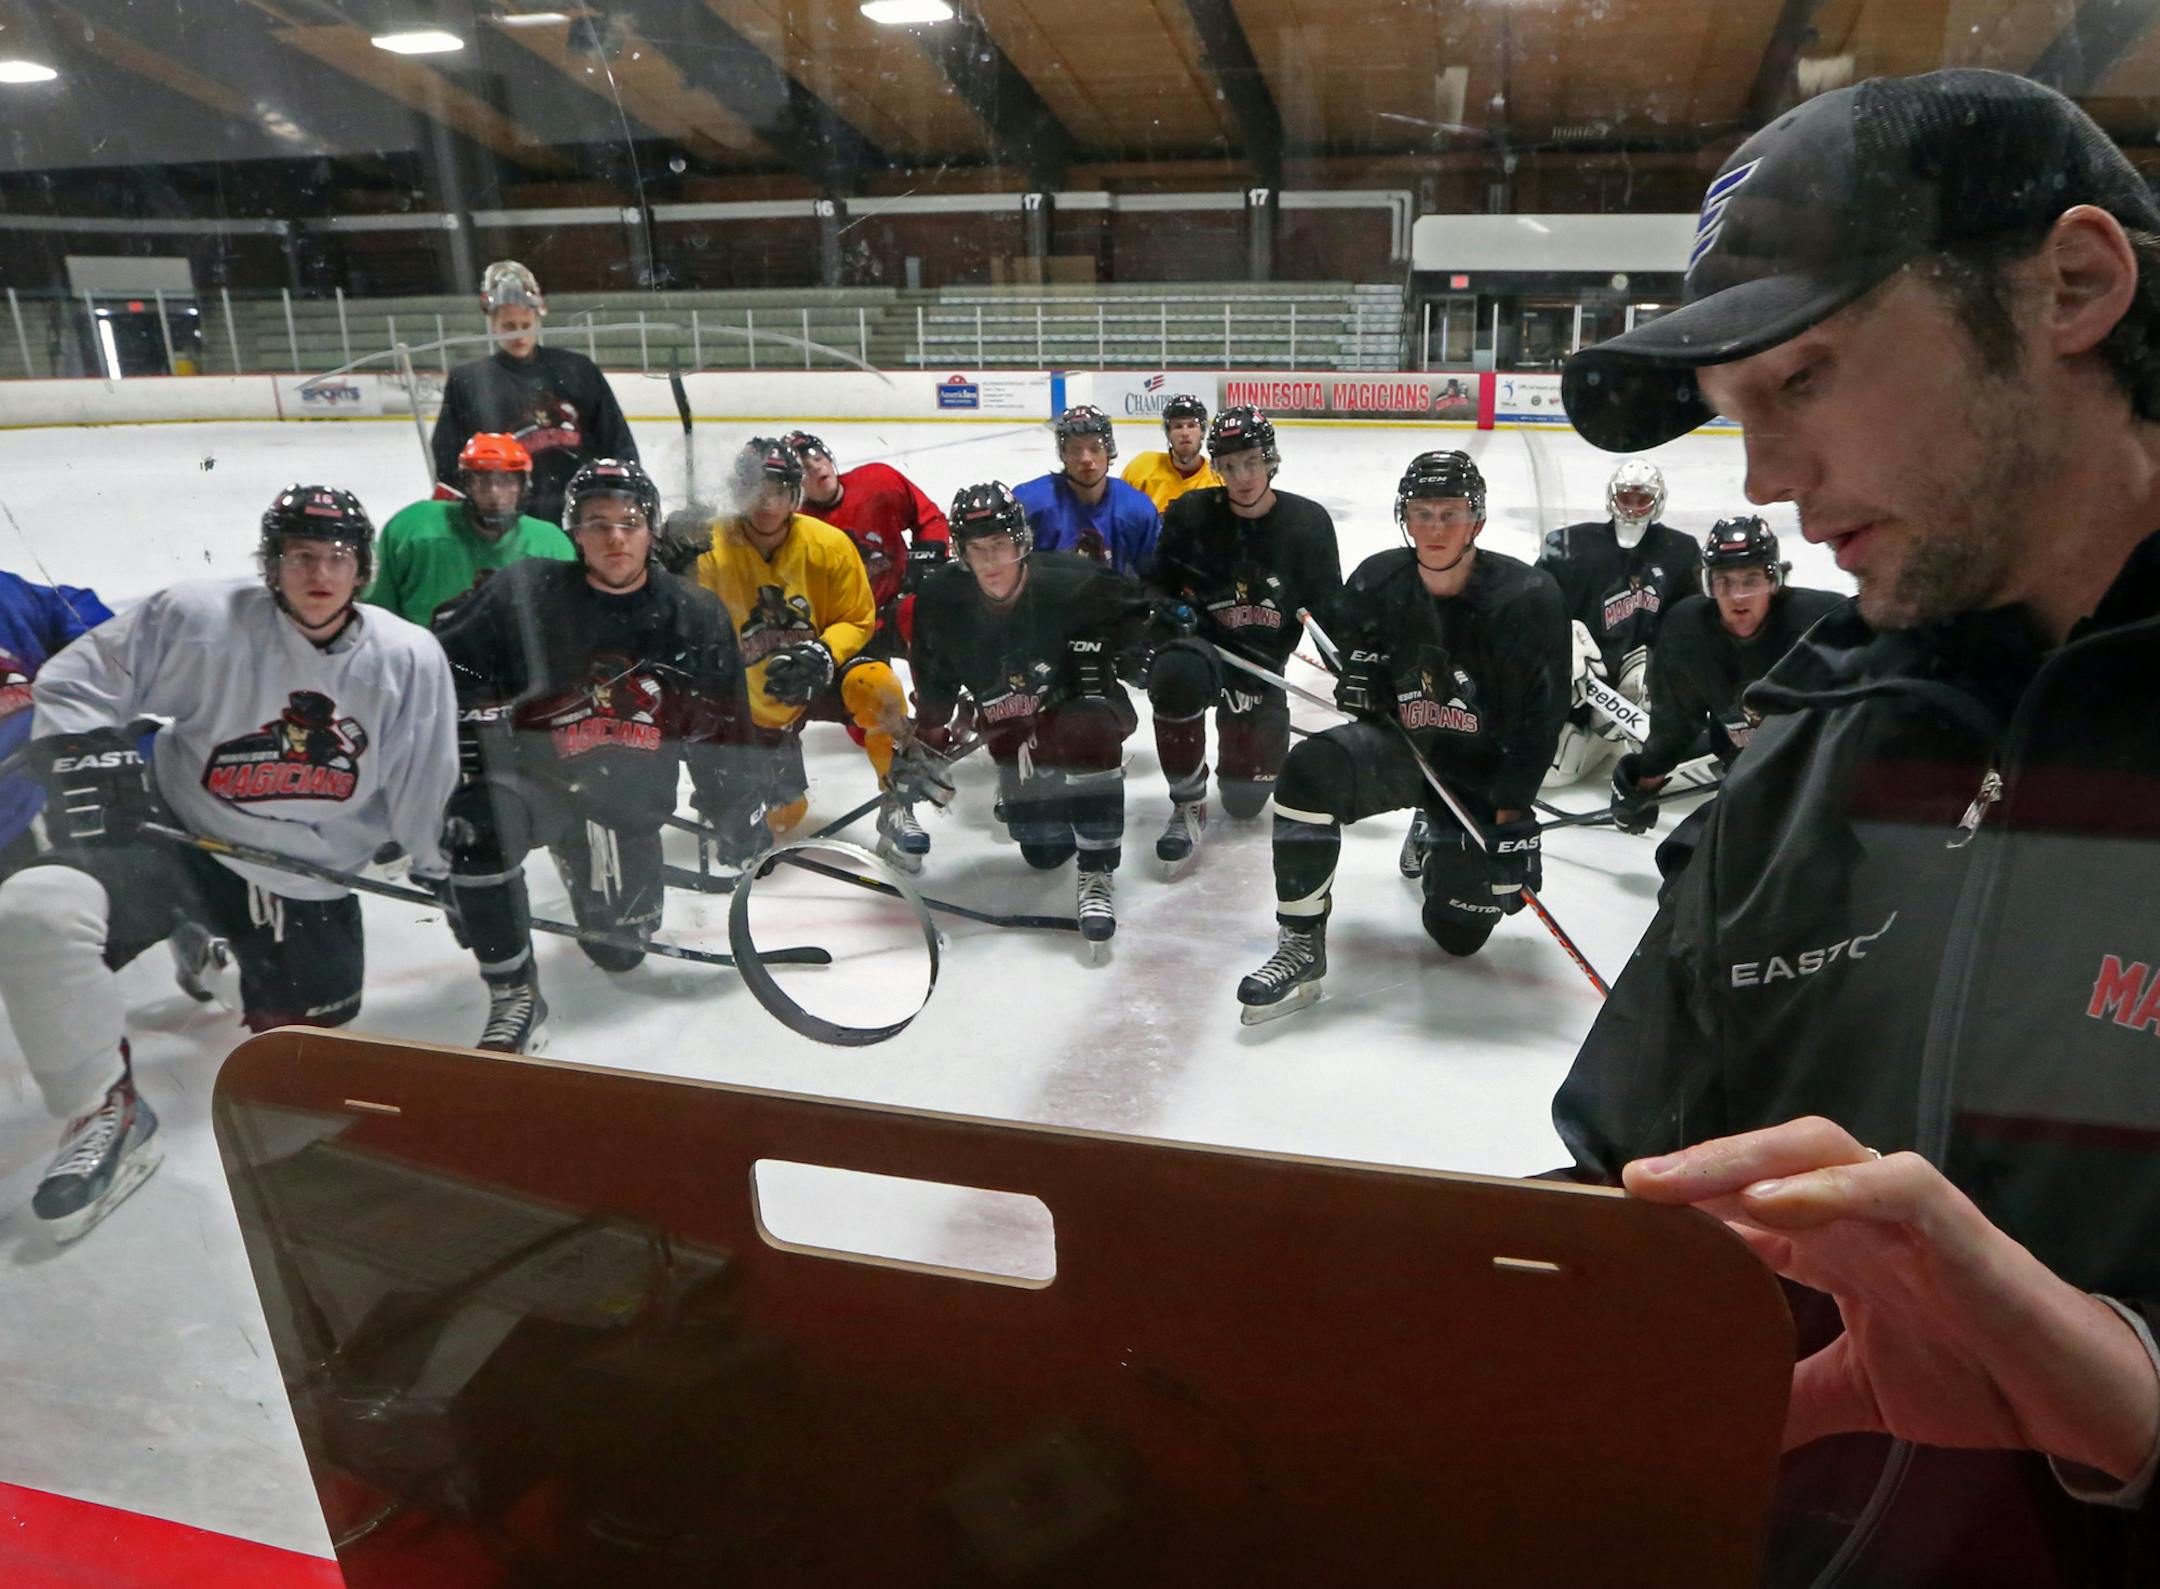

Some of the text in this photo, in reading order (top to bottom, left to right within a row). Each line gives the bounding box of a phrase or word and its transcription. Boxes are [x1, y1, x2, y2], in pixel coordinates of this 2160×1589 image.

[1024, 193, 1042, 210] 17
[1249, 188, 1270, 206] 17
[816, 200, 834, 217] 16
[1226, 382, 1325, 410] MINNESOTA
[1332, 383, 1430, 411] MAGICIANS
[207, 762, 355, 798] MAGICIANS
[1497, 836, 1541, 853] EAS
